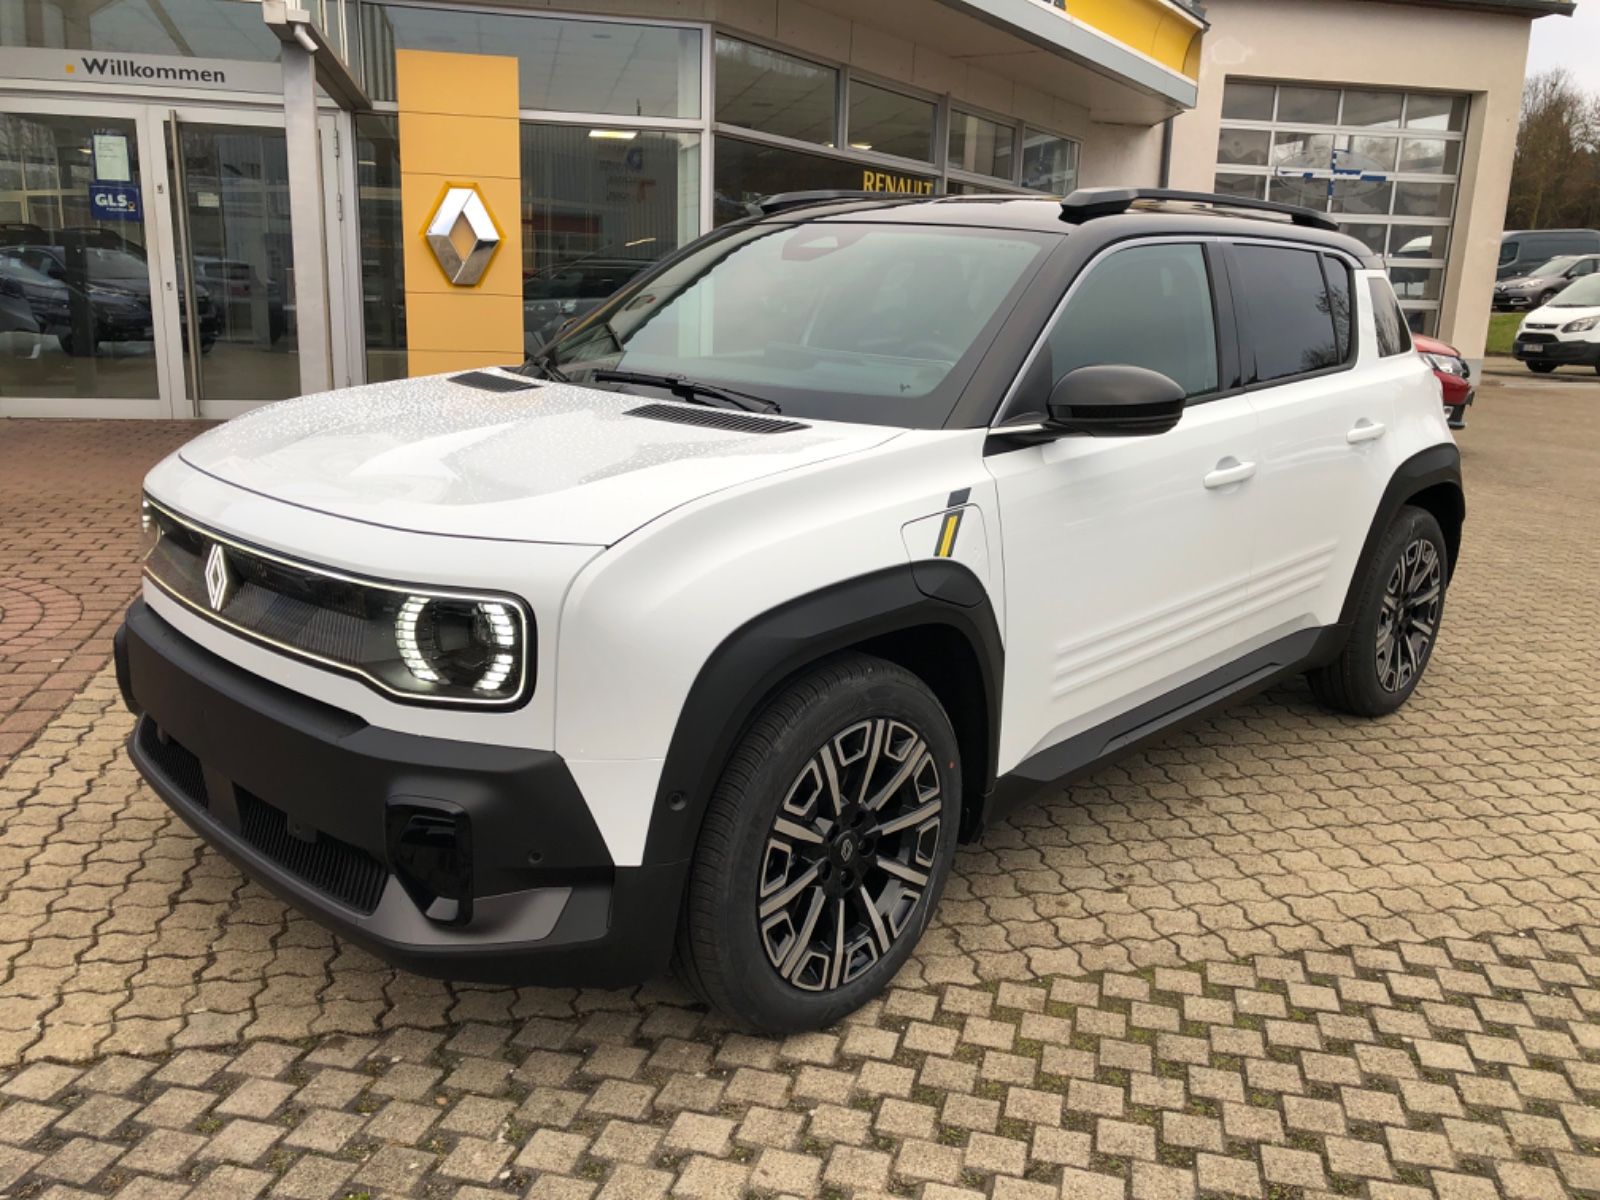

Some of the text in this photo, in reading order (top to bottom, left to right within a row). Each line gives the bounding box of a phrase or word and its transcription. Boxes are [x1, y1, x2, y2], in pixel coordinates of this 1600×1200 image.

[81, 57, 225, 83] Willkommen
[863, 170, 933, 195] RENAULT
[95, 193, 128, 207] GLS
